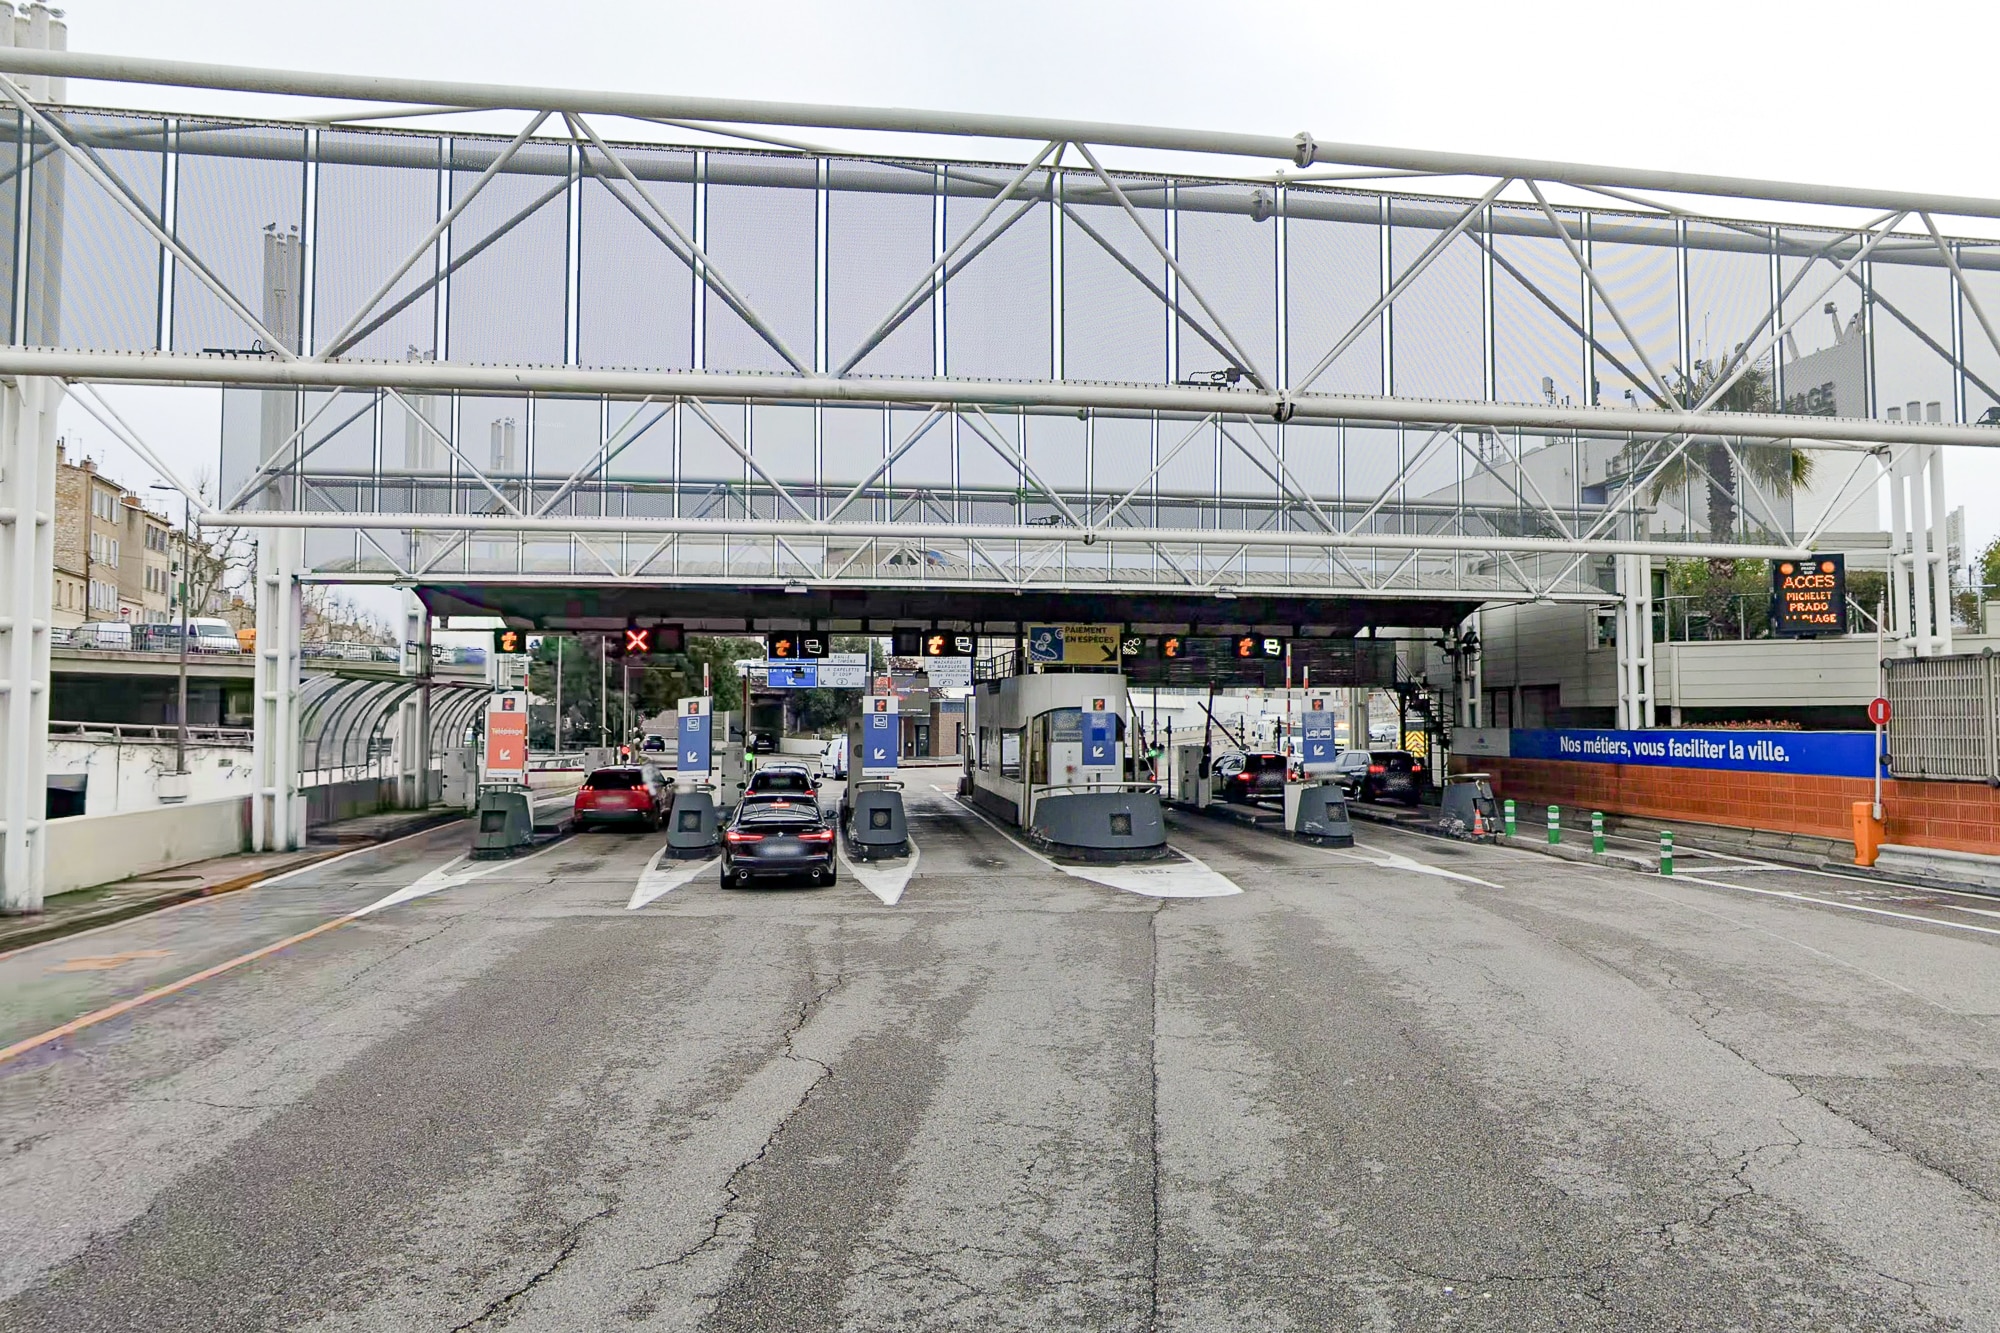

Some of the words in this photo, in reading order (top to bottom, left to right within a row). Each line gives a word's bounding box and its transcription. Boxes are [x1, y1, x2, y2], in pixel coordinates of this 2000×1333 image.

[1783, 575, 1835, 589] ACCES
[1786, 591, 1832, 601] MICHELET
[1789, 602, 1829, 612] PRADO
[1064, 626, 1108, 634] PAIEMENT
[1560, 736, 1581, 753] Nos
[1583, 736, 1631, 758] métiers,
[1633, 742, 1665, 757] vous
[1667, 738, 1726, 760] faciliter
[1729, 740, 1744, 760] la
[1748, 740, 1790, 762] ville.
